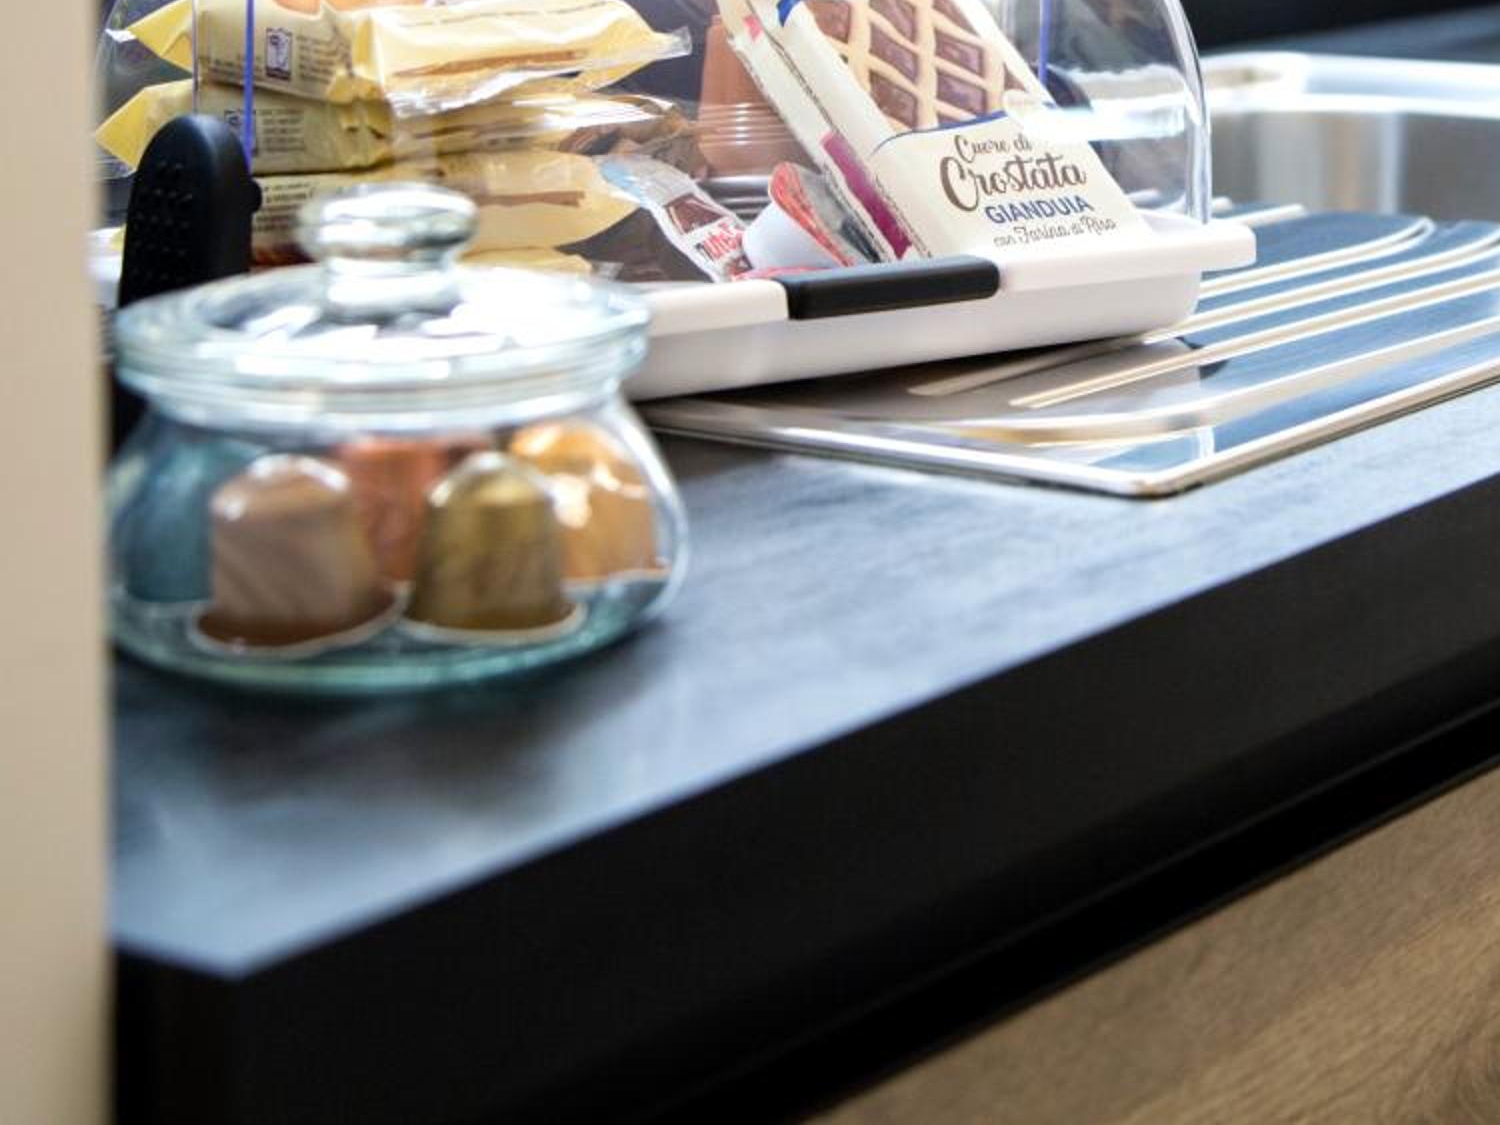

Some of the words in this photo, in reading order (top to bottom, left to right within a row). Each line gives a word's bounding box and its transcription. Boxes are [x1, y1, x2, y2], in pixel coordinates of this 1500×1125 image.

[954, 134, 1011, 164] Cuore
[1013, 132, 1033, 154] di
[940, 151, 1087, 213] Crostata
[984, 194, 1095, 225] GIANDUIA
[1013, 223, 1070, 245] Farina
